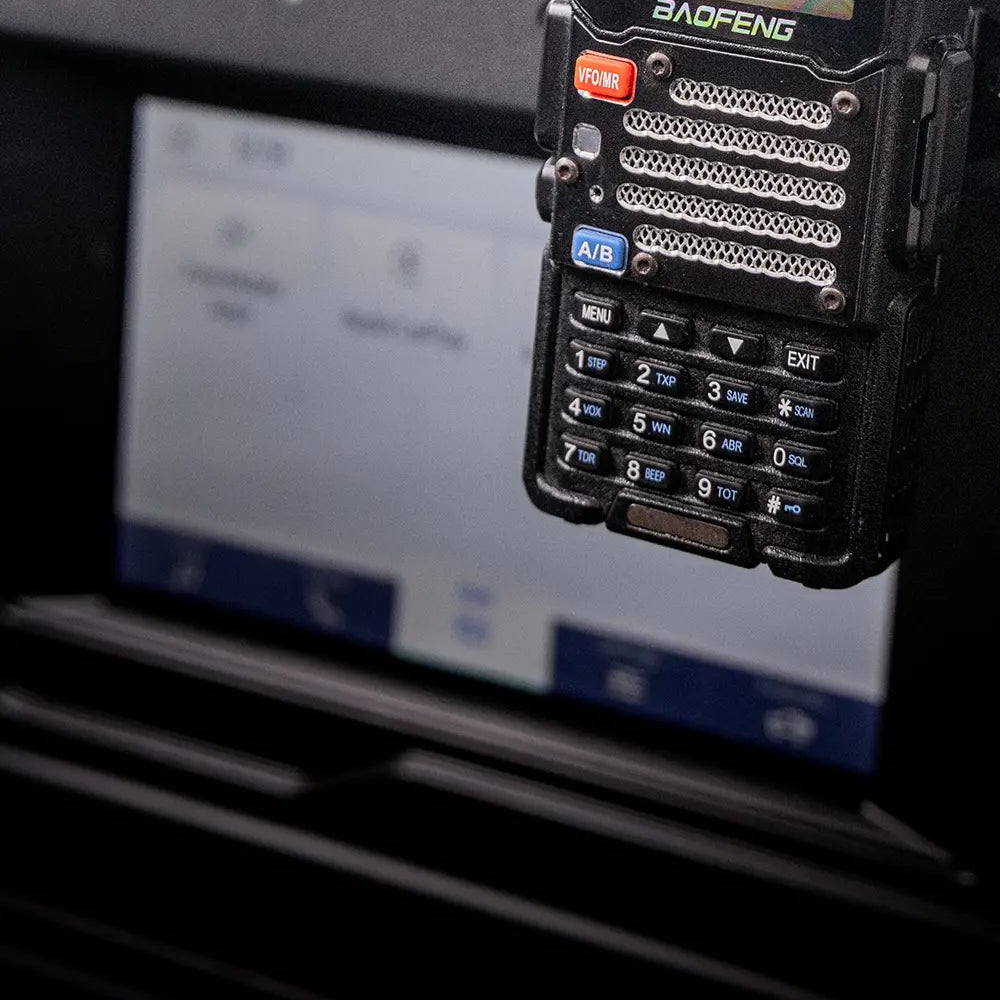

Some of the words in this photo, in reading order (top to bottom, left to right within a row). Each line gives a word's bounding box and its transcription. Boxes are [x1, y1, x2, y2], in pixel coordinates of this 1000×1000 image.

[578, 66, 620, 90] VFO/MR
[578, 239, 615, 265] A/B
[581, 305, 612, 325] MENU
[575, 350, 584, 370] 1
[586, 355, 607, 371] STEP
[787, 350, 820, 373] EXIT
[636, 363, 651, 385] 2
[655, 372, 677, 387] TXP
[707, 380, 722, 402] 3
[726, 389, 749, 406] SAVE
[568, 397, 582, 417] 4
[582, 405, 602, 418] VOX
[793, 404, 814, 419] SCAN
[632, 413, 647, 434] 5
[564, 441, 578, 462] 7
[577, 449, 596, 465] TDR
[702, 430, 717, 451] 6
[721, 437, 743, 453] ABR
[773, 446, 787, 468] 0
[787, 454, 808, 469] SQL
[626, 459, 641, 481] 8
[644, 467, 666, 483] BEEP
[697, 477, 712, 499] 9
[717, 485, 739, 501] TOT
